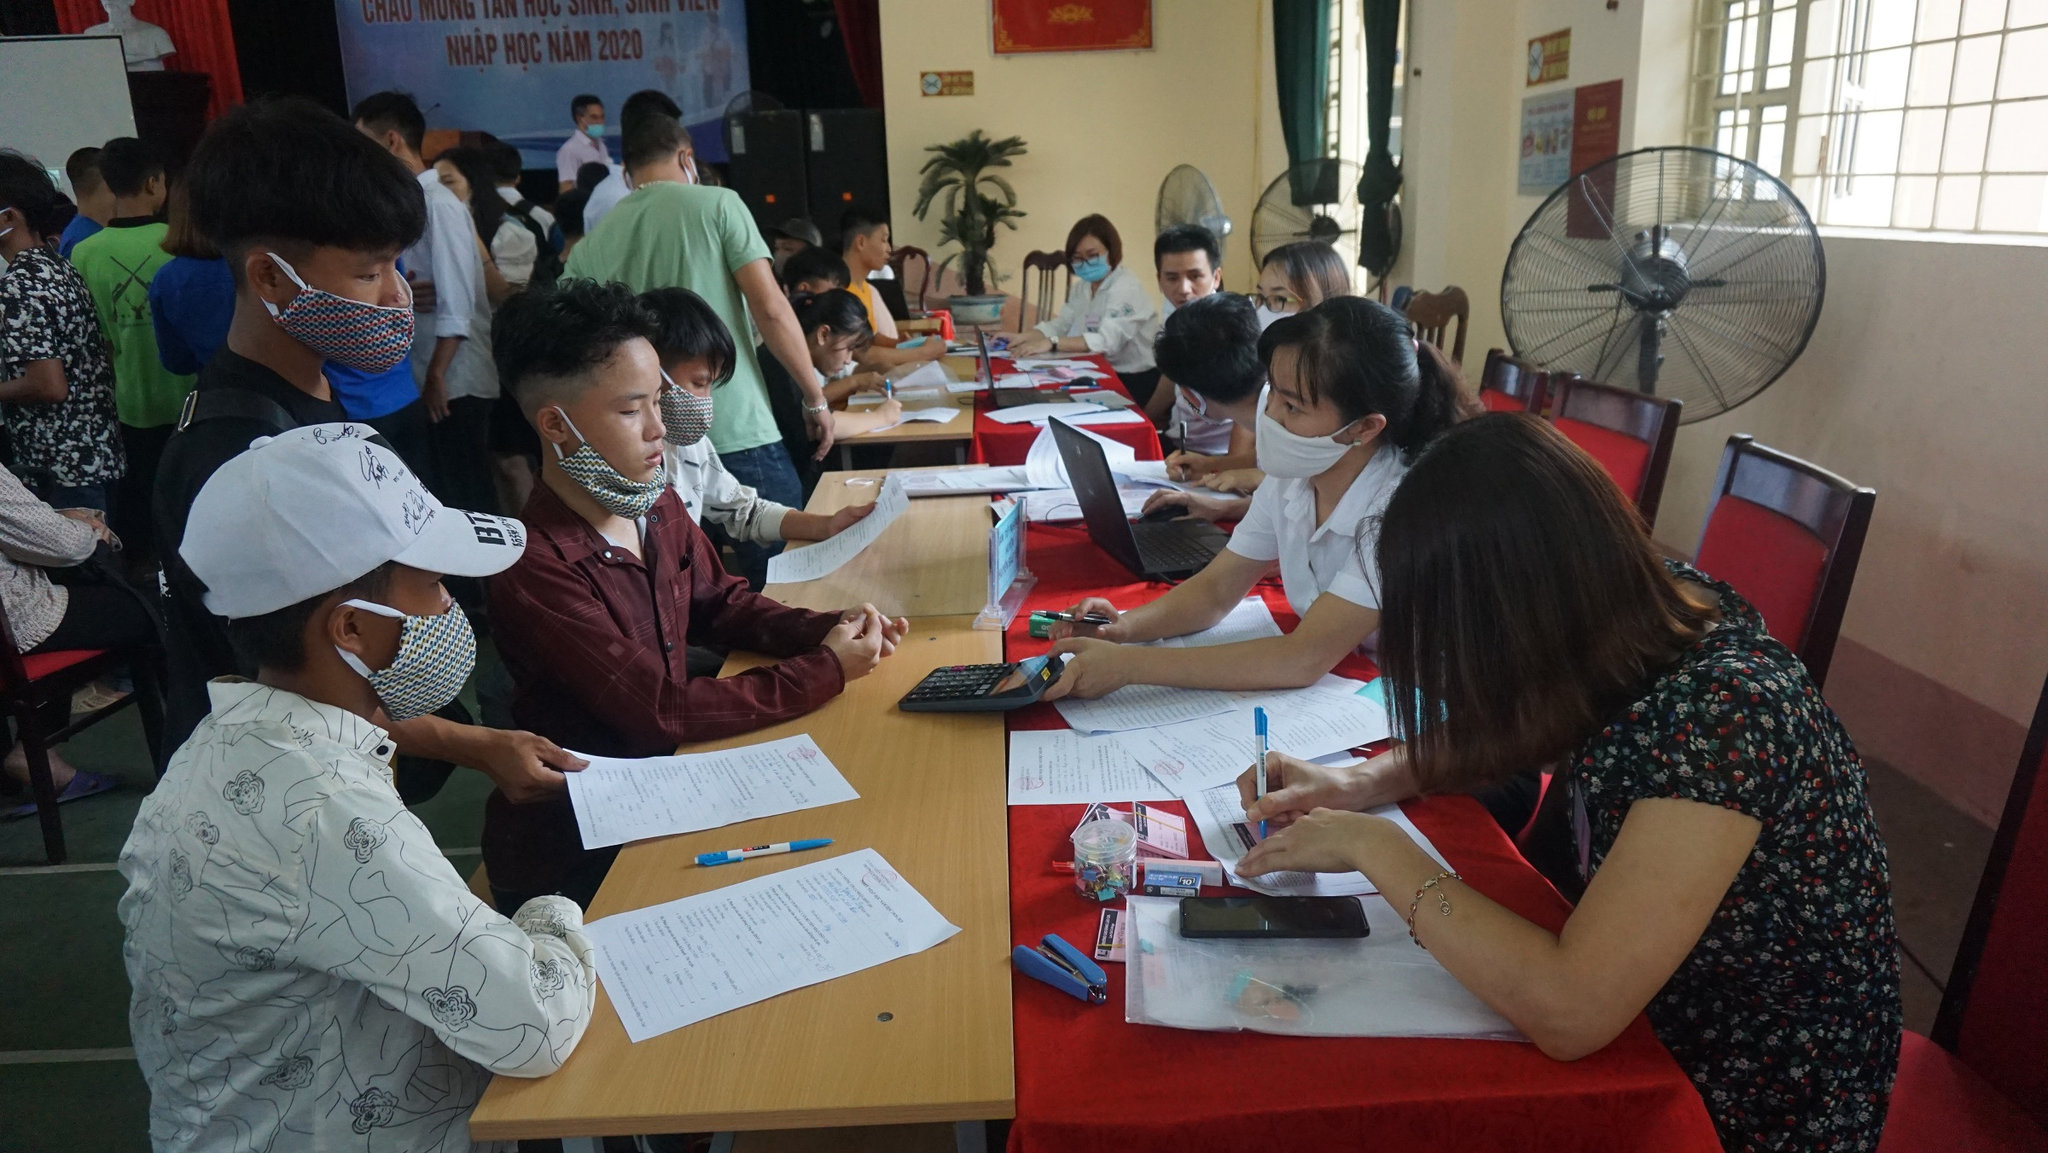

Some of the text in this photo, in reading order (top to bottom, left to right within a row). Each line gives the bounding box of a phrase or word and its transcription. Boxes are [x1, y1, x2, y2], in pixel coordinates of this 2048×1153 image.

[445, 25, 643, 73] NHẬP HỌC NĂM 2020
[1181, 878, 1193, 886] 10
